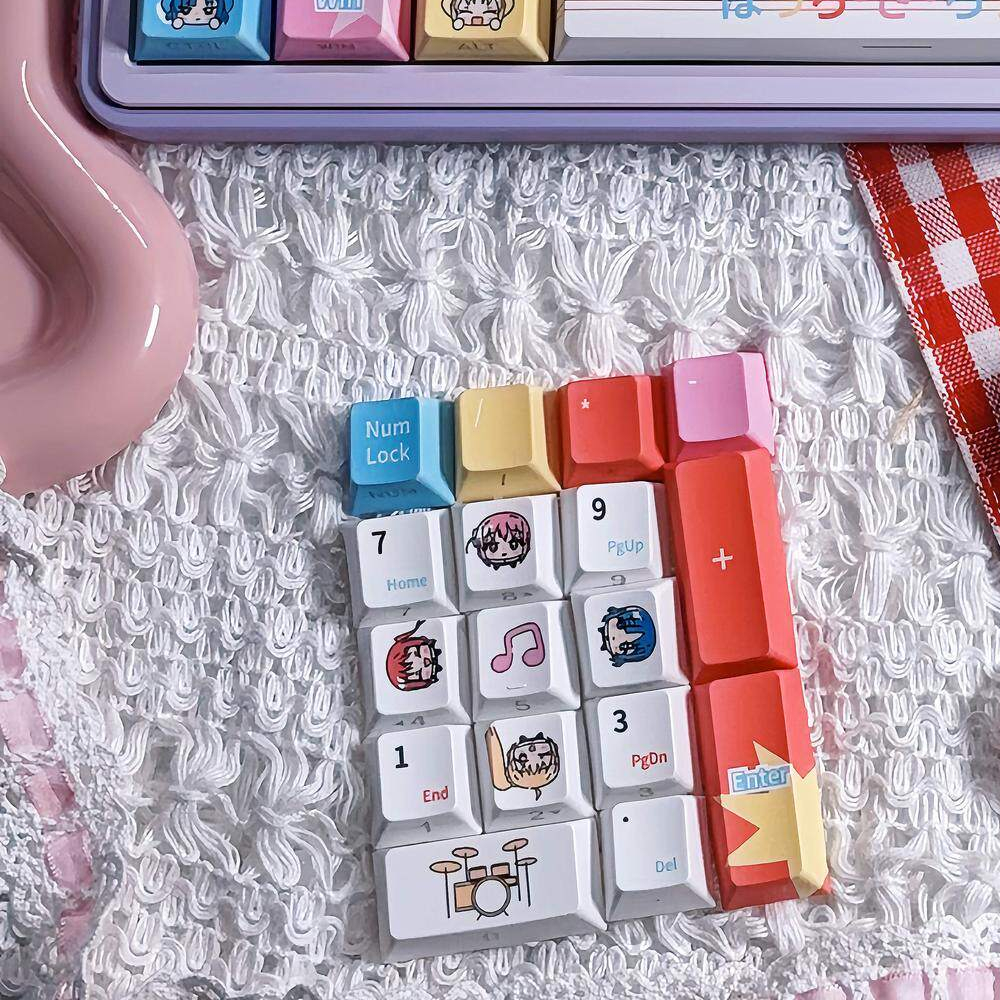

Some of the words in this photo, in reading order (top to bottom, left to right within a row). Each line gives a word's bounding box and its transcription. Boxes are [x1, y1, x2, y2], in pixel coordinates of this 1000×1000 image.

[364, 417, 411, 439] Num
[365, 444, 411, 467] Lock
[592, 498, 606, 520] 9
[372, 531, 386, 554] 7
[386, 575, 428, 593] Home
[613, 710, 628, 733] 3
[395, 746, 408, 768] 1
[630, 751, 668, 771] PgDn
[731, 764, 790, 790] Enter
[421, 786, 450, 804] End
[655, 857, 679, 873] Del
